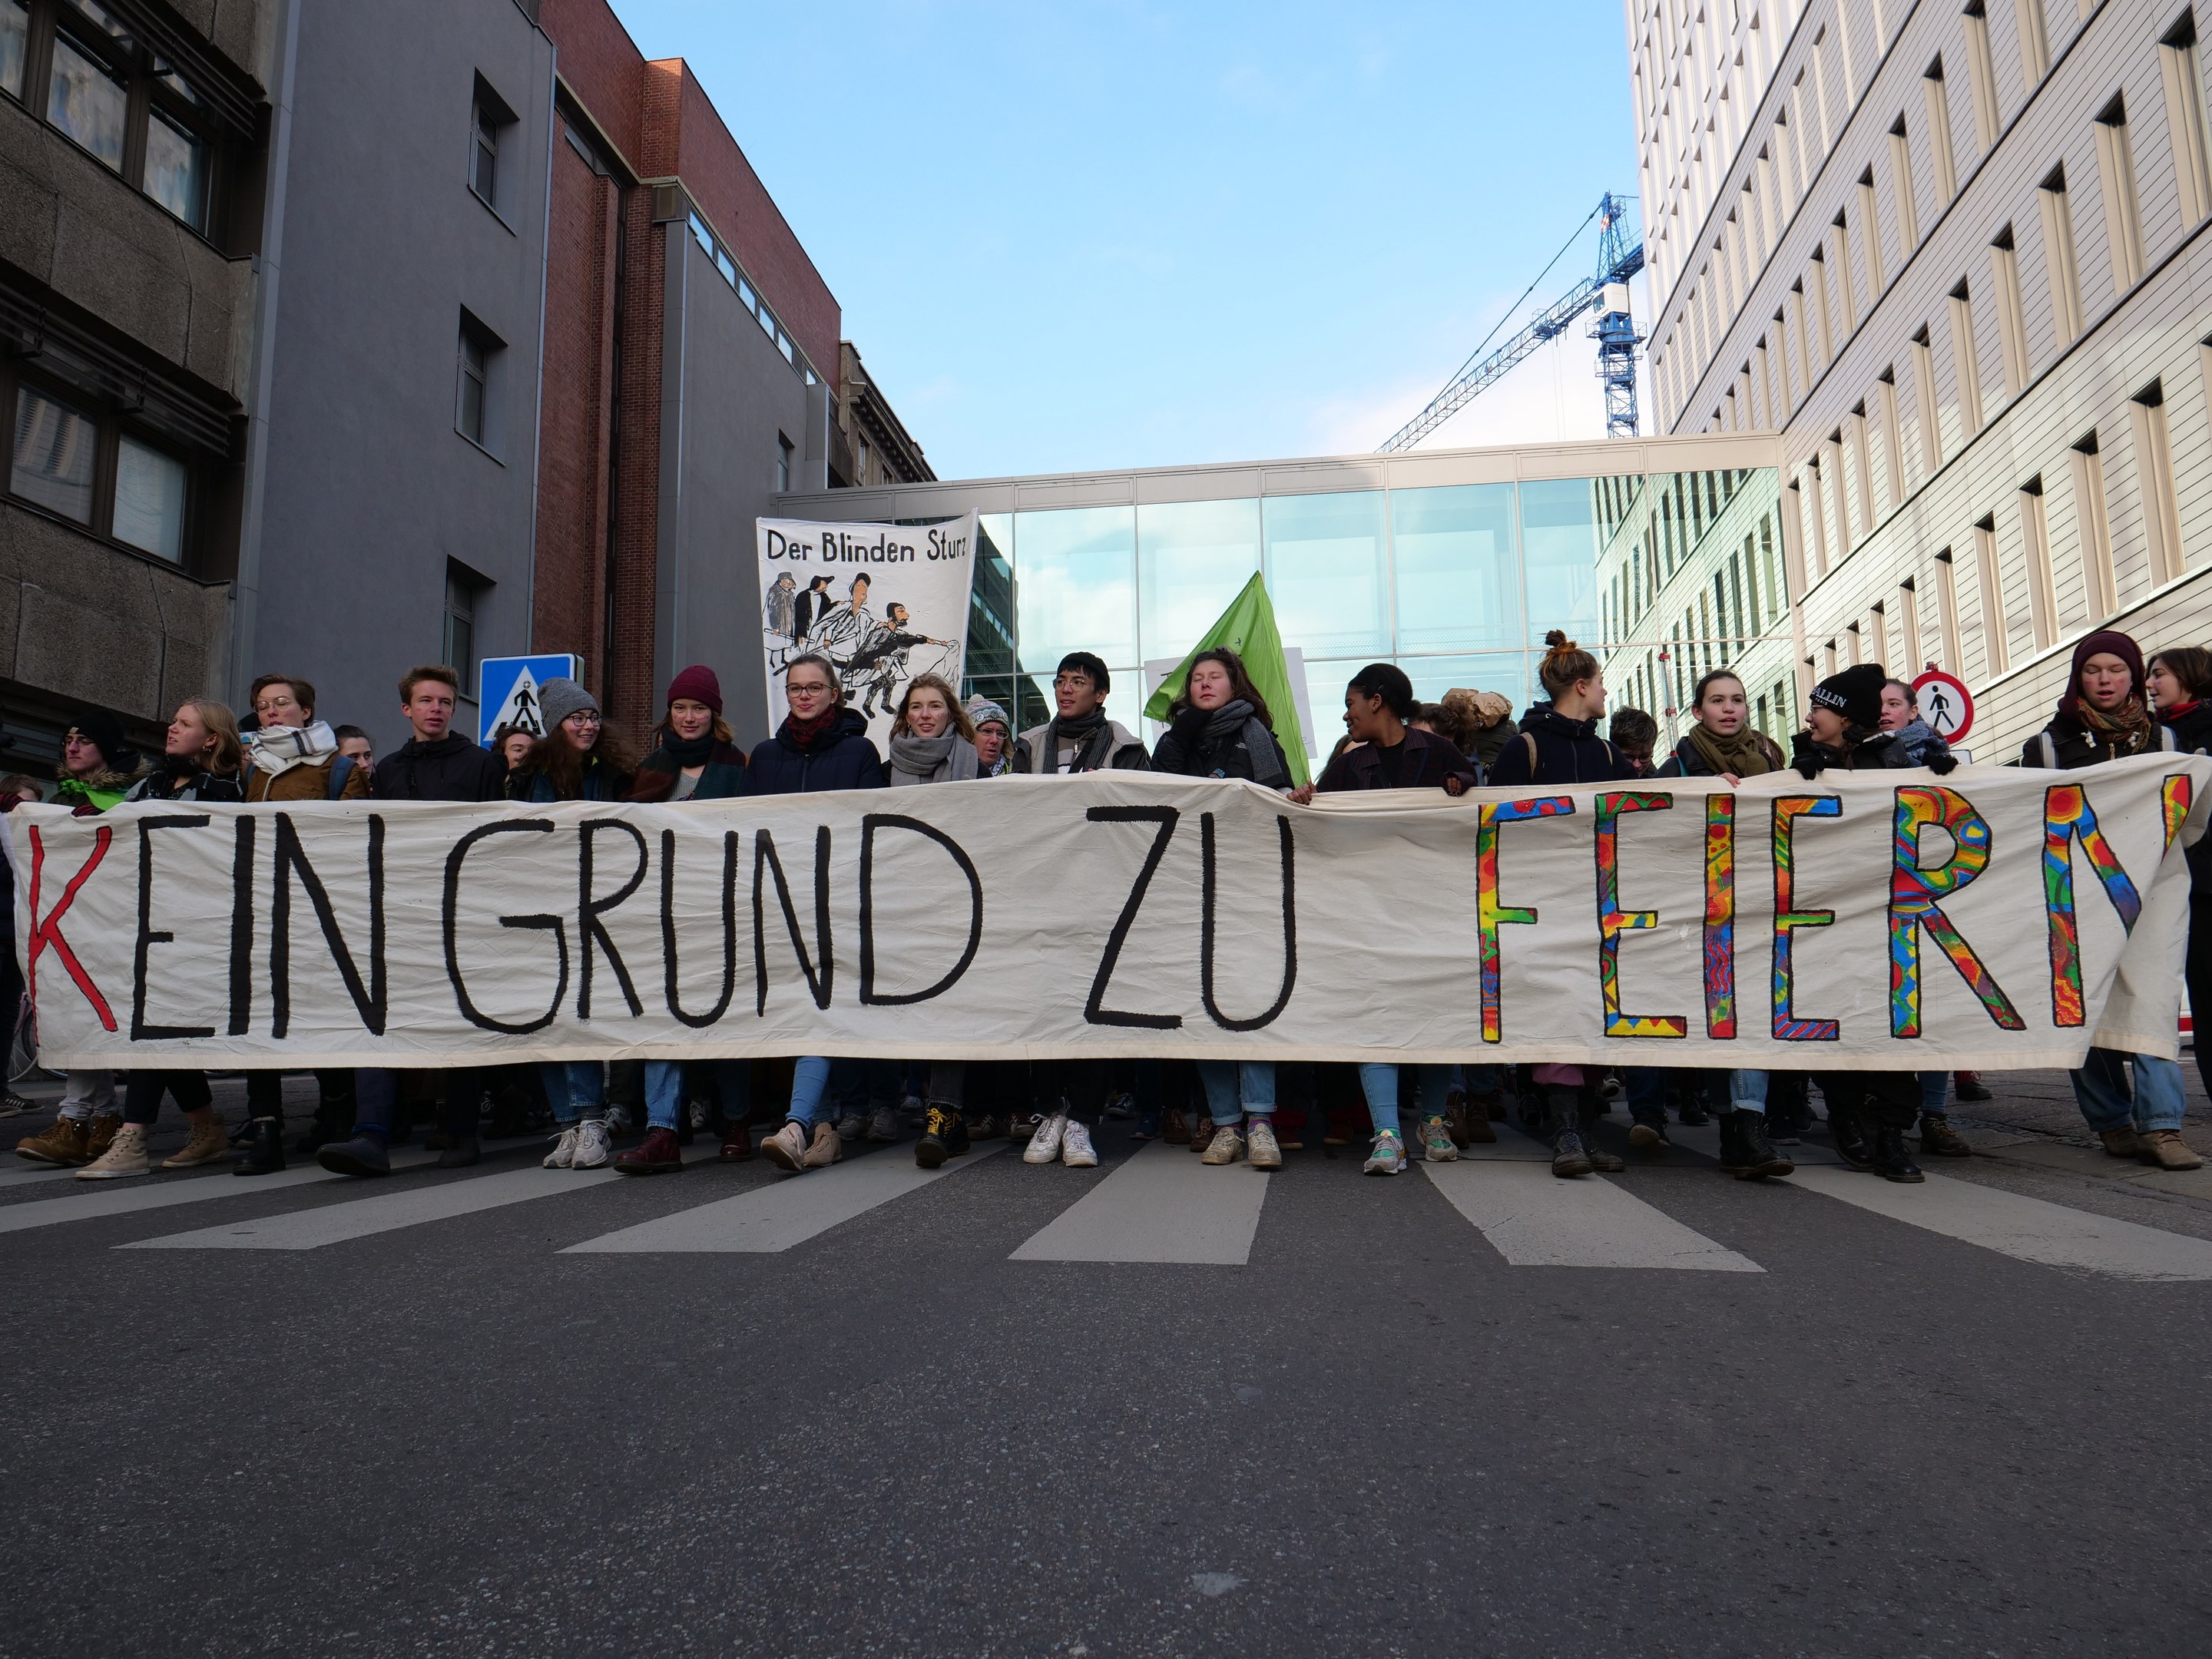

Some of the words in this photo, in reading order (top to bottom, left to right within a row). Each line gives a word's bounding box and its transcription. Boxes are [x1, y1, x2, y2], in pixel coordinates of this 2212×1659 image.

[767, 529, 813, 561] Der
[822, 531, 915, 562] Blinden
[926, 528, 966, 561] Sturz
[28, 812, 389, 1046] KEIN
[442, 813, 983, 1035] GRUND
[1083, 805, 1297, 1031] ZU
[1476, 773, 2194, 1043] FEIERN
